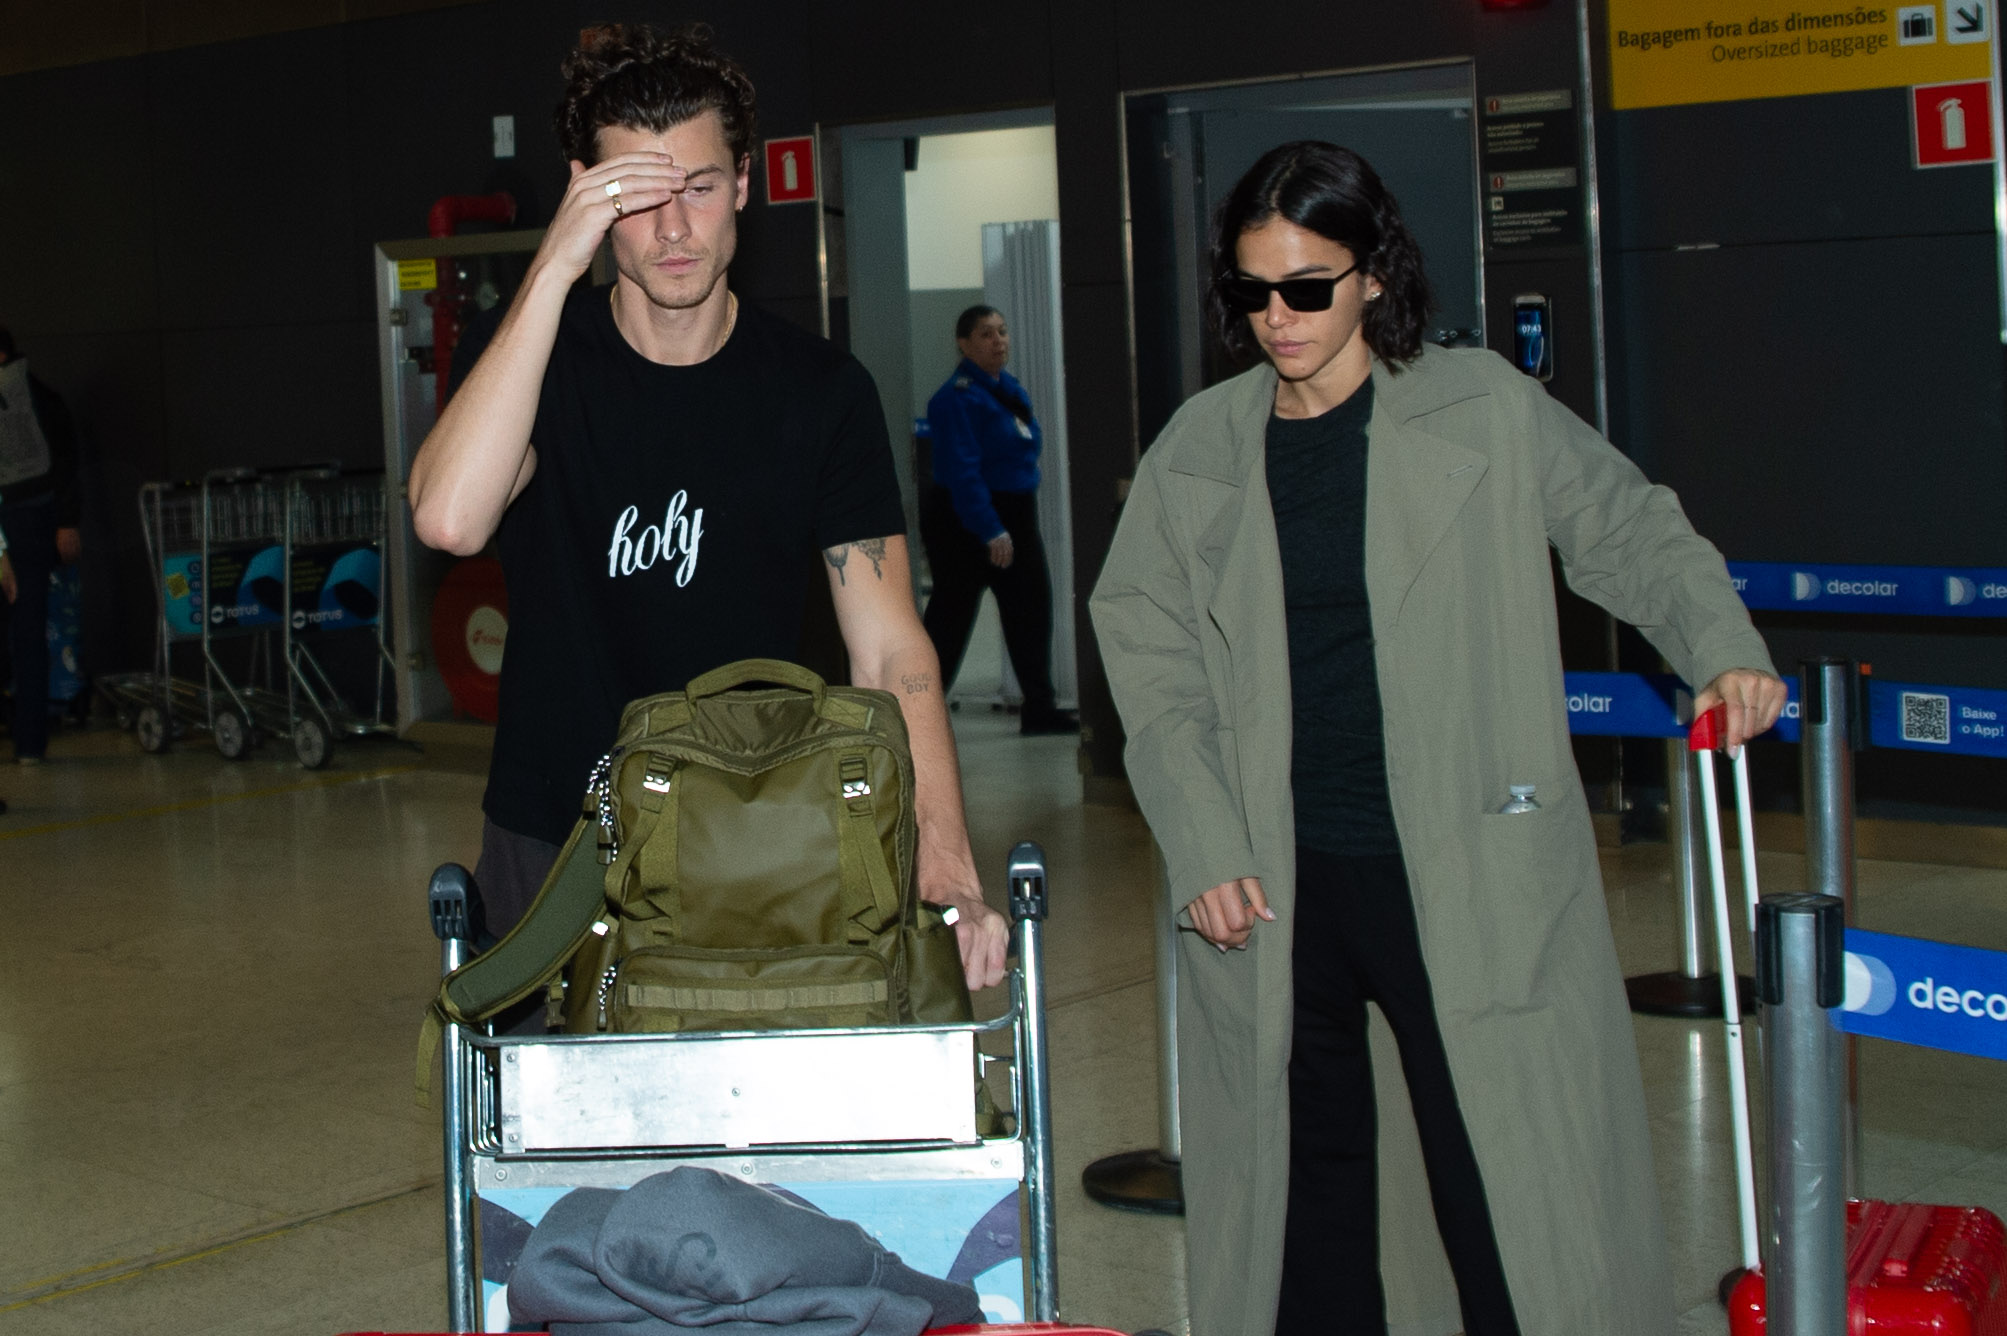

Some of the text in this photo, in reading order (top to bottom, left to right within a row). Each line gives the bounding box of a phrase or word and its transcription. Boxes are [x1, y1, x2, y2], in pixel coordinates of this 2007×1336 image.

[1618, 7, 1888, 50] Bagagem fora das dimensões
[1711, 31, 1889, 63] Oversized baggage
[608, 489, 704, 588] holy
[1826, 579, 1899, 597] decolar
[906, 683, 929, 695] BOY
[1564, 693, 1613, 712] olar
[1962, 706, 1997, 720] Baixe
[1962, 724, 2004, 739] o App!
